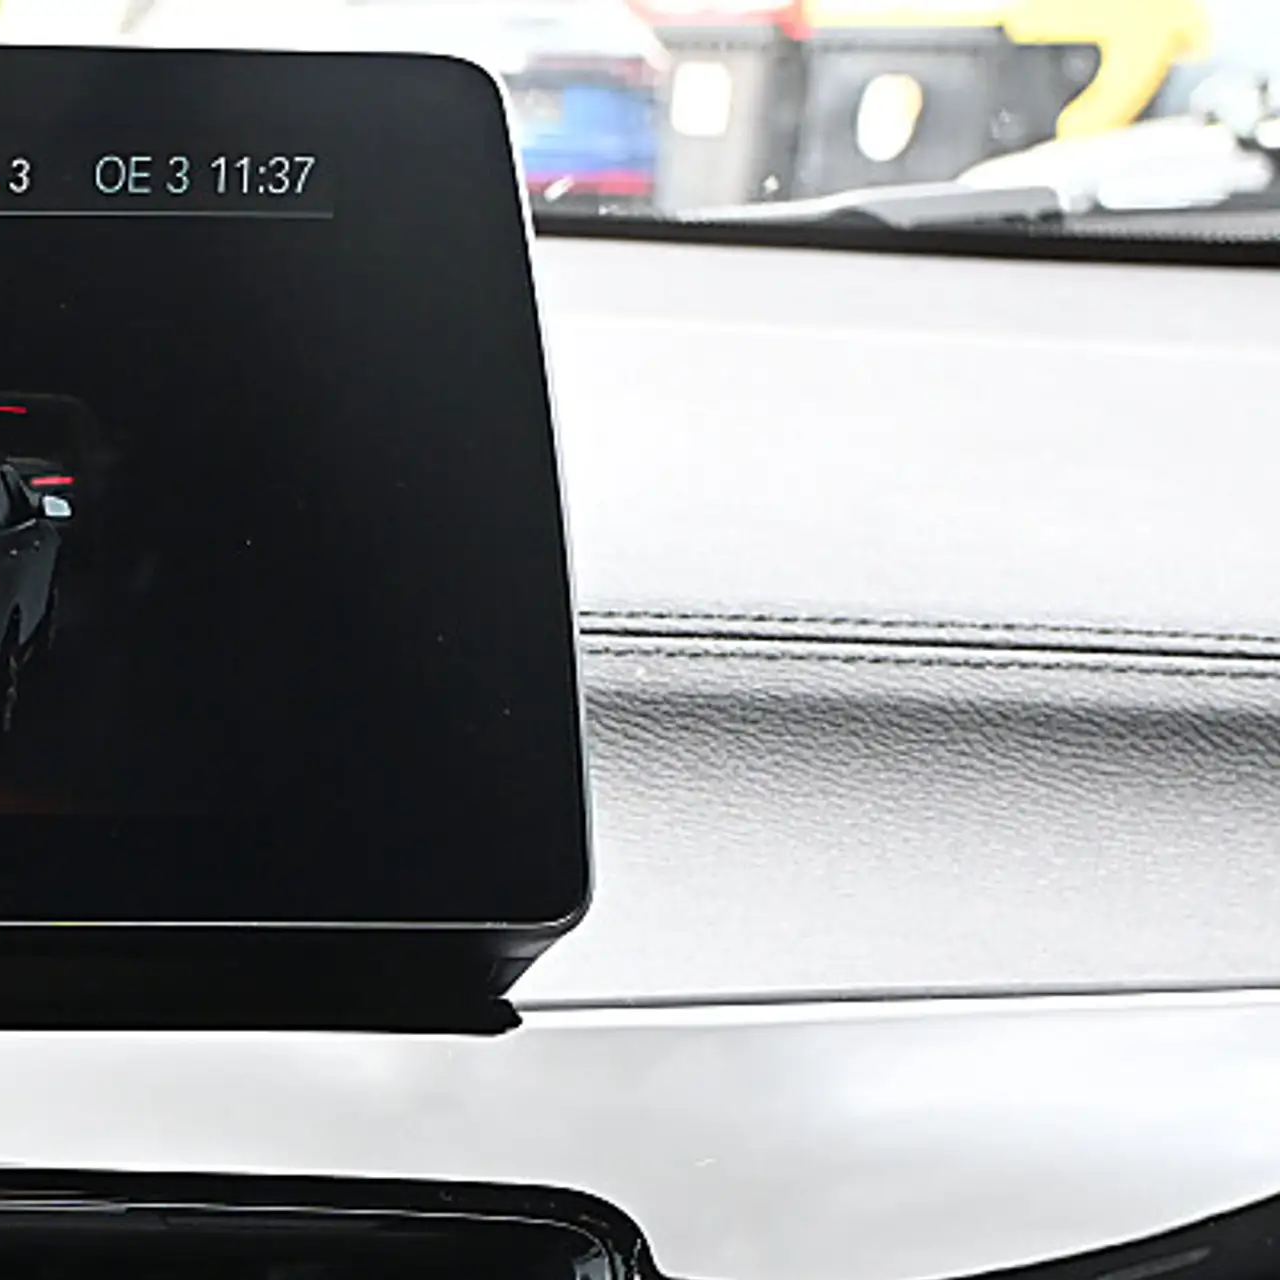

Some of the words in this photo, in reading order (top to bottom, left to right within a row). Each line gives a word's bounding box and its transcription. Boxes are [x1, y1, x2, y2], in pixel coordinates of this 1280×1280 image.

[10, 159, 29, 192] 3
[96, 157, 151, 192] OE
[167, 157, 188, 193] 3
[212, 157, 314, 193] 11:37
